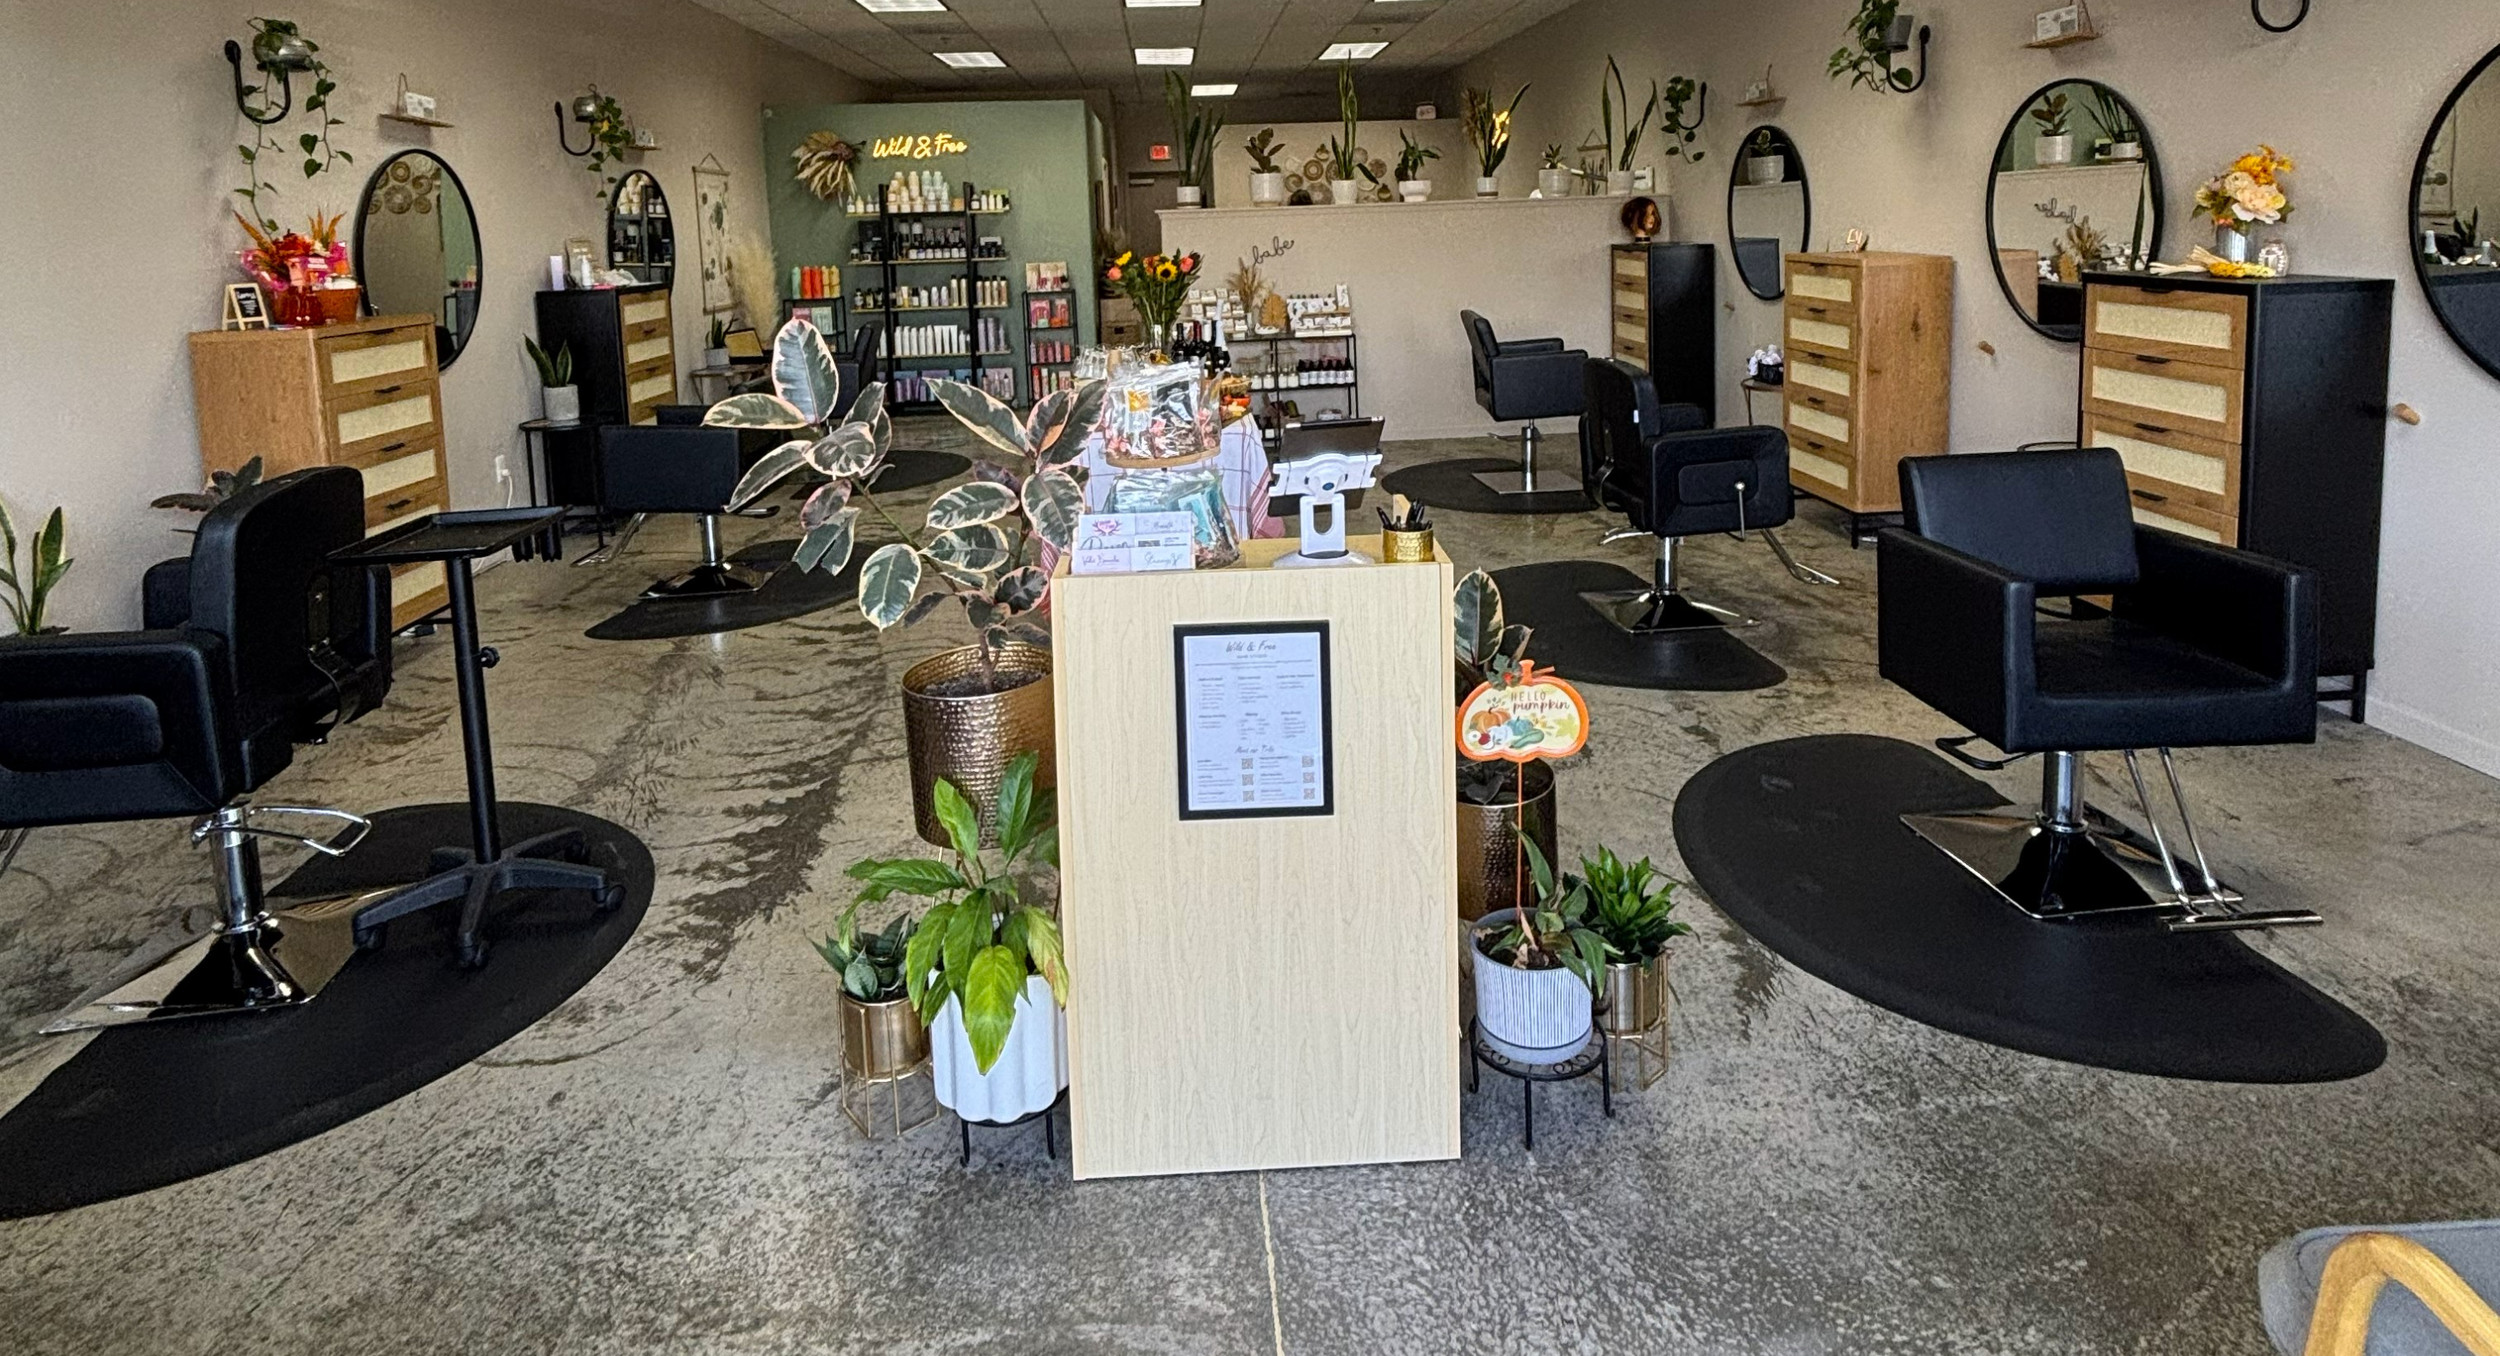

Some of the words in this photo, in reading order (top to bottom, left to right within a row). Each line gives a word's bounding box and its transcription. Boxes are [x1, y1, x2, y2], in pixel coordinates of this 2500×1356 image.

[873, 136, 913, 158] Wild
[913, 135, 932, 159] &
[934, 133, 968, 156] Free
[1252, 235, 1295, 265] babe
[1226, 641, 1244, 653] Wild
[1246, 641, 1254, 652] &
[1258, 639, 1277, 651] Free
[1510, 691, 1547, 702] HELLO
[1512, 699, 1570, 714] pumpkin
